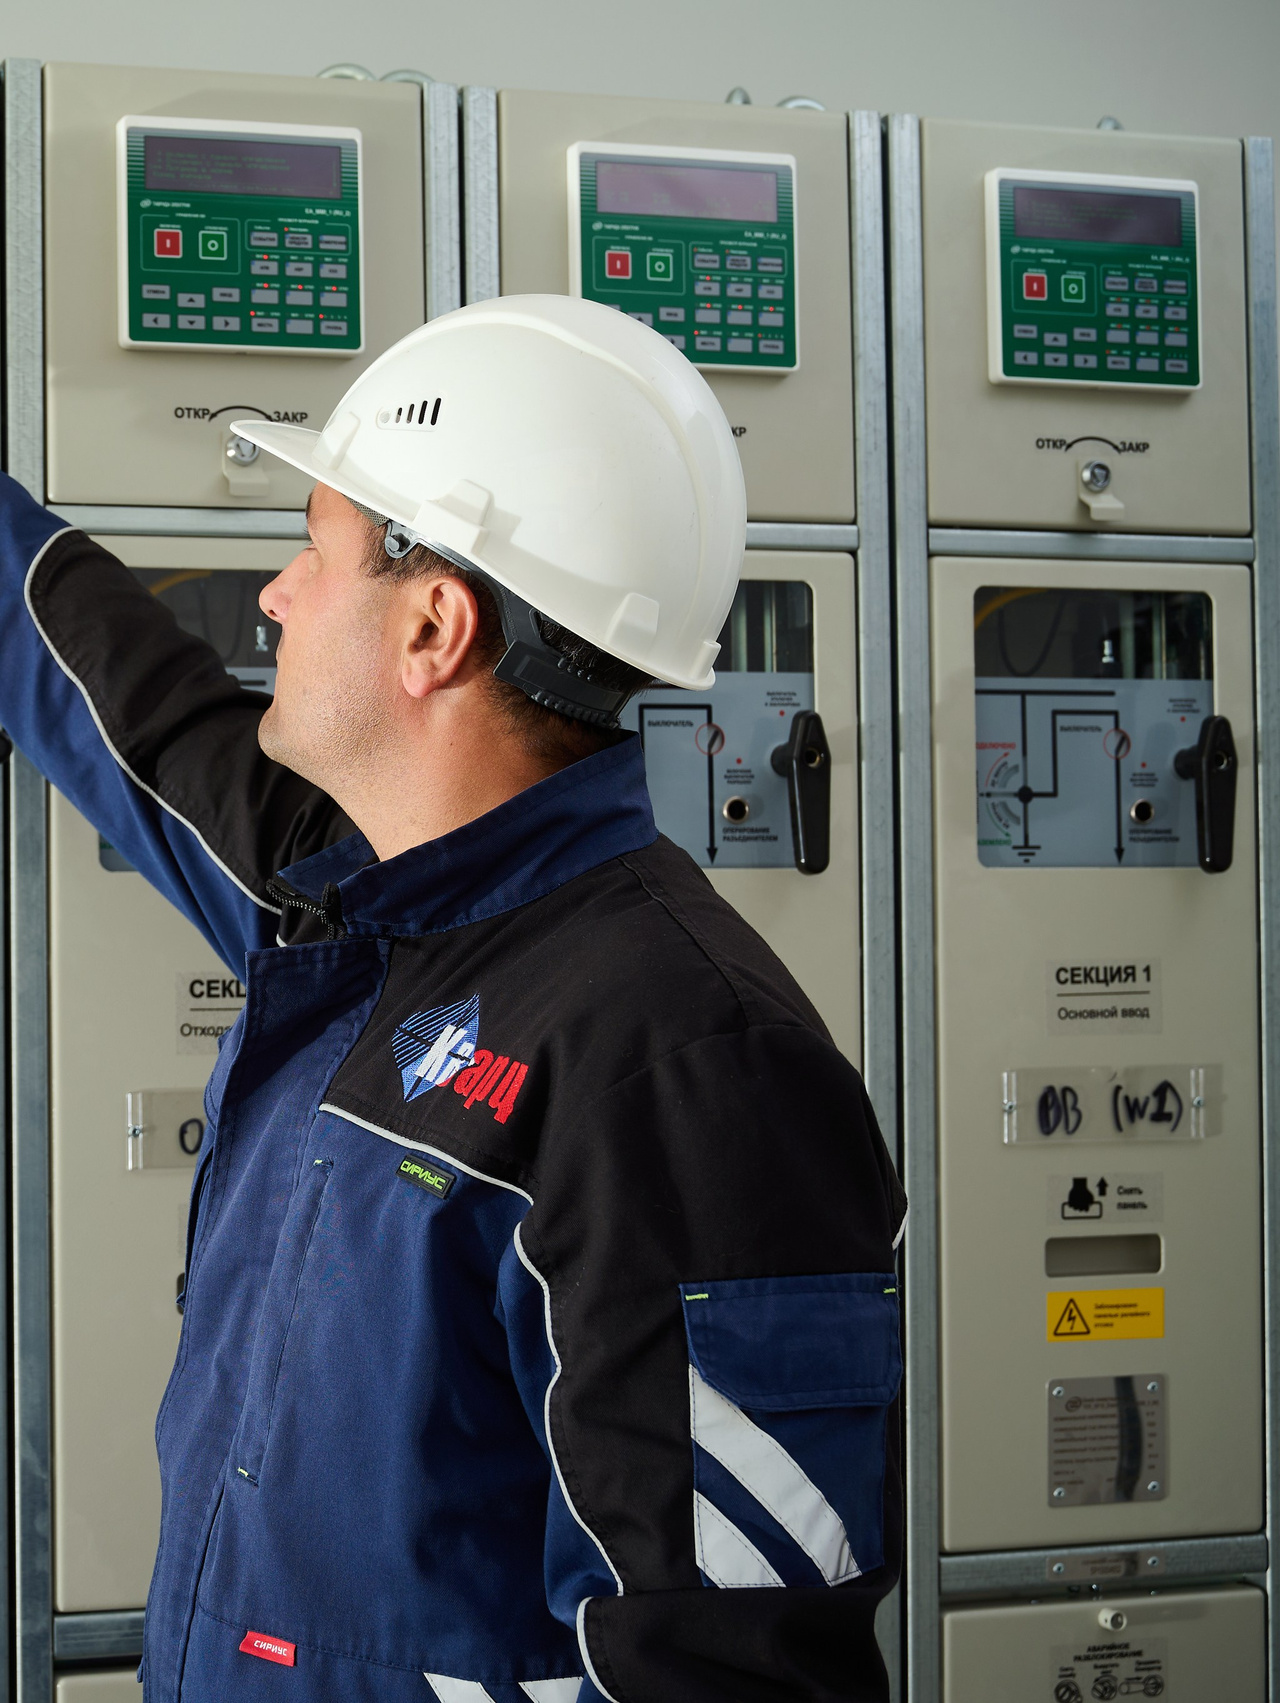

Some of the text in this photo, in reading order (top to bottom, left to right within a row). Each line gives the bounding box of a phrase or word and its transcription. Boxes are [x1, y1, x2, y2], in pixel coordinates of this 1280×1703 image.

[174, 407, 308, 423] ОТКР ЗАКР
[1036, 438, 1149, 453] ОТКР ЗАКР
[647, 720, 694, 728] ВЫКЛЮЧАТЕЛЬ
[1056, 965, 1151, 986] СЕКЦИЯ 1
[1057, 1006, 1150, 1020] Основной ввод
[400, 1160, 446, 1190] СИРИУС
[253, 1639, 288, 1657] СИРИУС
